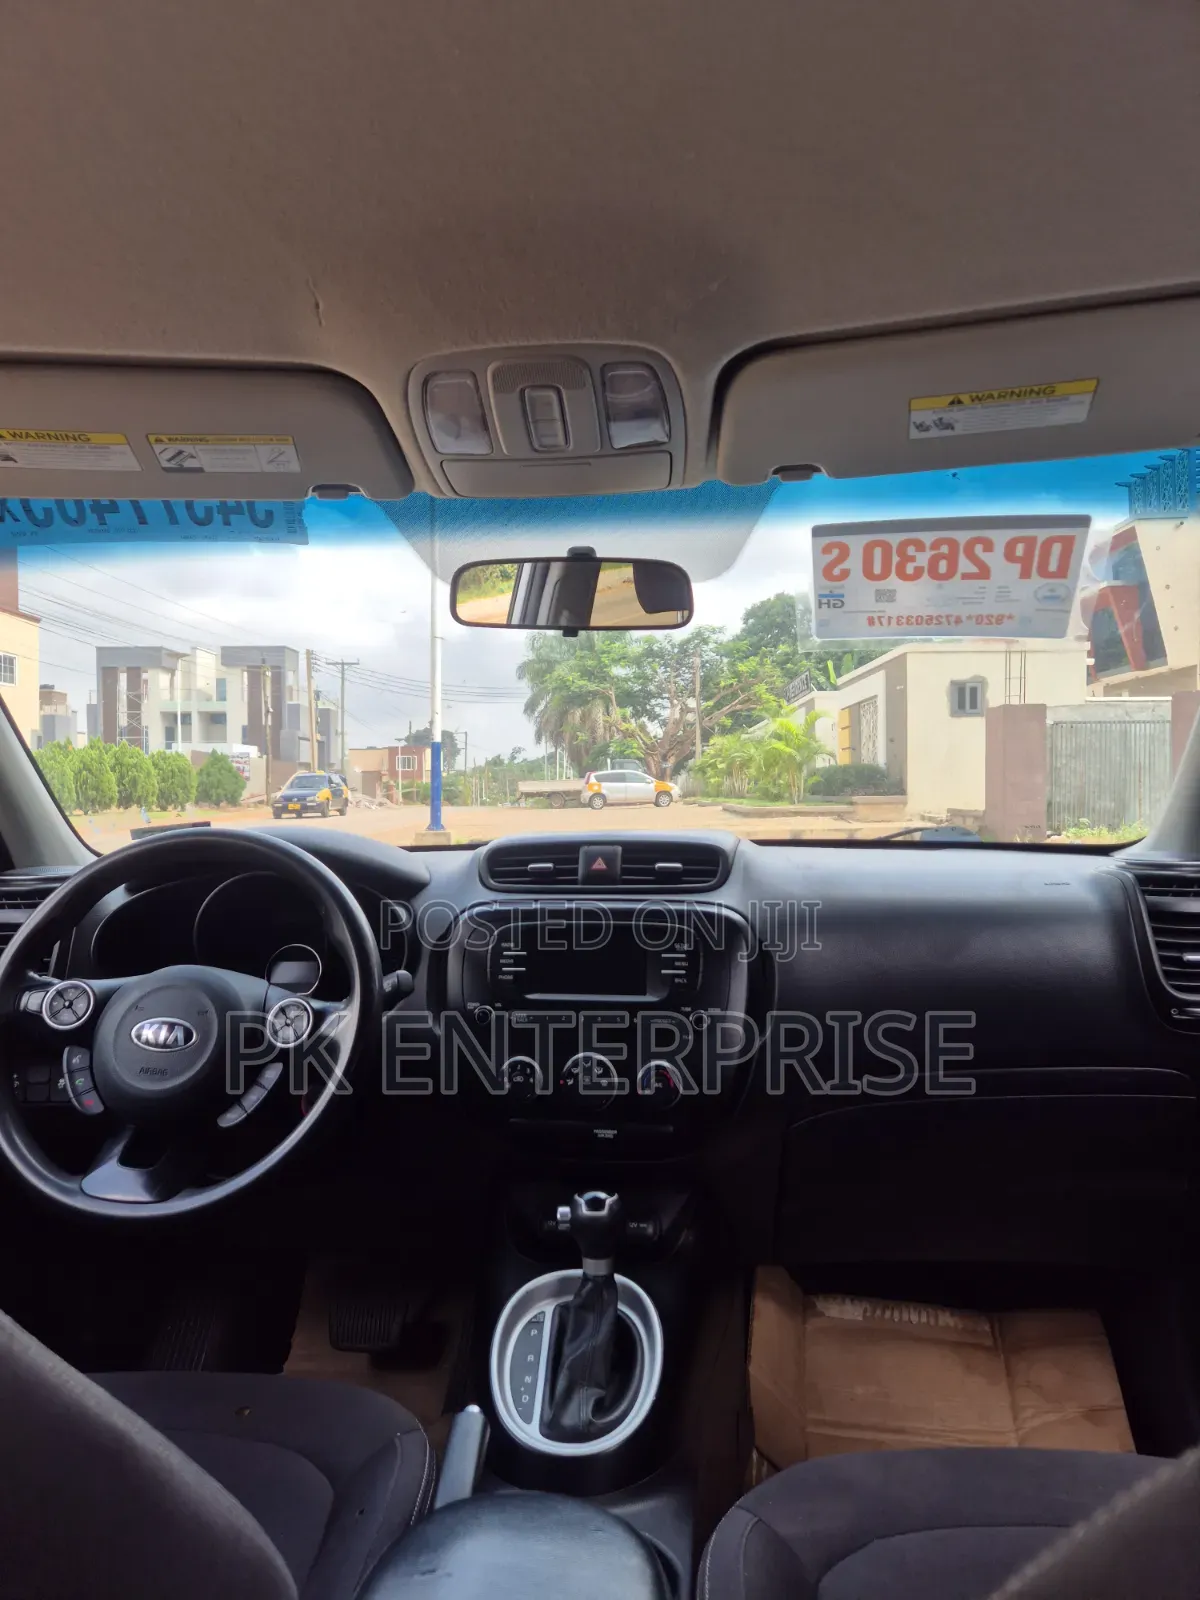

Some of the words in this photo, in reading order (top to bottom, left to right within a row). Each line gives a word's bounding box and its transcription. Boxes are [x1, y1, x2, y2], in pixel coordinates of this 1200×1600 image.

[969, 385, 1056, 403] WARNING
[7, 430, 91, 442] WARNING
[140, 1023, 185, 1046] KIA
[138, 1066, 169, 1076] AIRBAG
[524, 1375, 532, 1383] N
[521, 1394, 529, 1403] D
